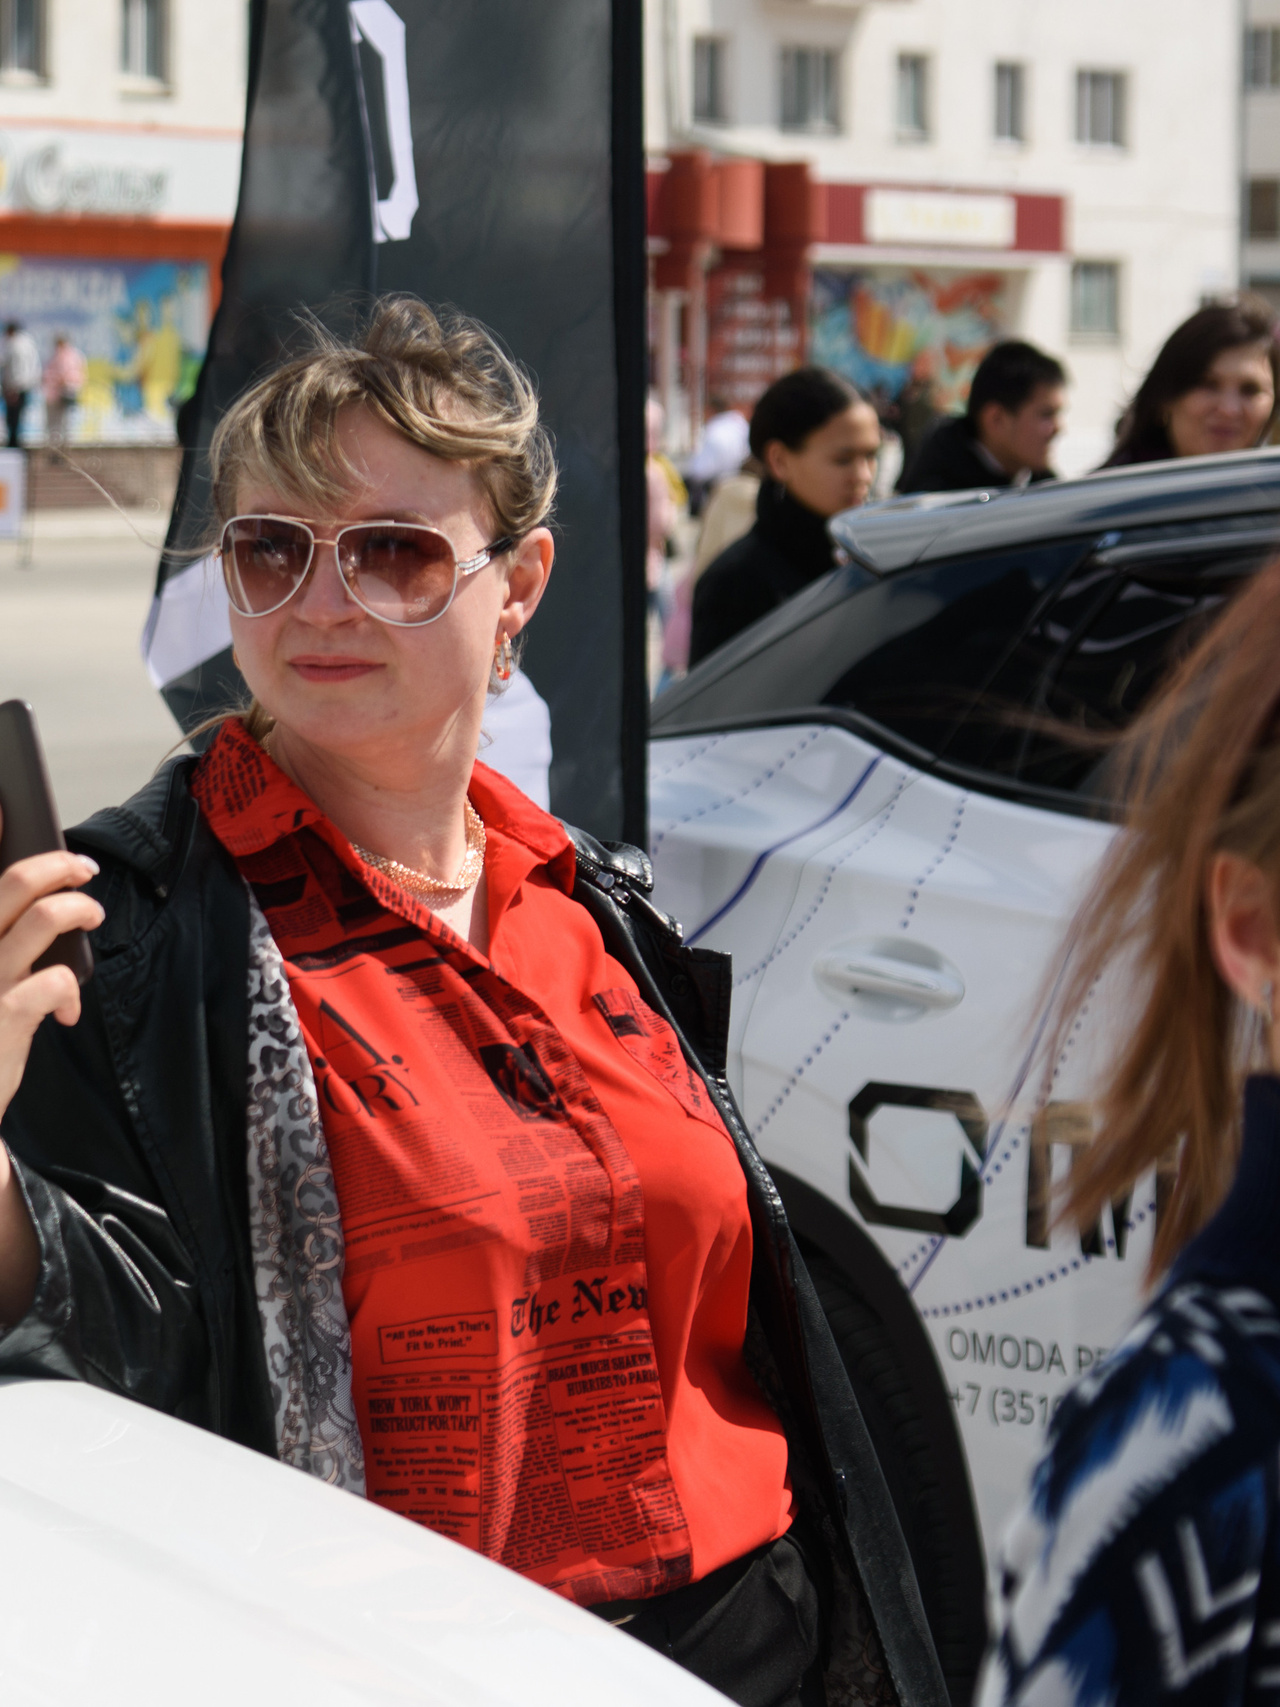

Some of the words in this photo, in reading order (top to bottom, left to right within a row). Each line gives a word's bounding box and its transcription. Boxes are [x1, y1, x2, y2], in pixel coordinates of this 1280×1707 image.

[510, 1290, 561, 1338] The
[407, 1328, 424, 1338] the
[426, 1324, 456, 1335] News
[406, 1341, 420, 1352] Fit
[423, 1340, 435, 1349] to
[949, 1328, 1067, 1376] OMODA
[580, 1358, 611, 1377] MUCH
[567, 1374, 614, 1397] HURRIES
[613, 1373, 627, 1388] TO
[368, 1398, 396, 1414] NEW
[400, 1395, 433, 1412] YORK
[370, 1415, 425, 1433] INSTRUCT
[427, 1415, 450, 1431] FOR
